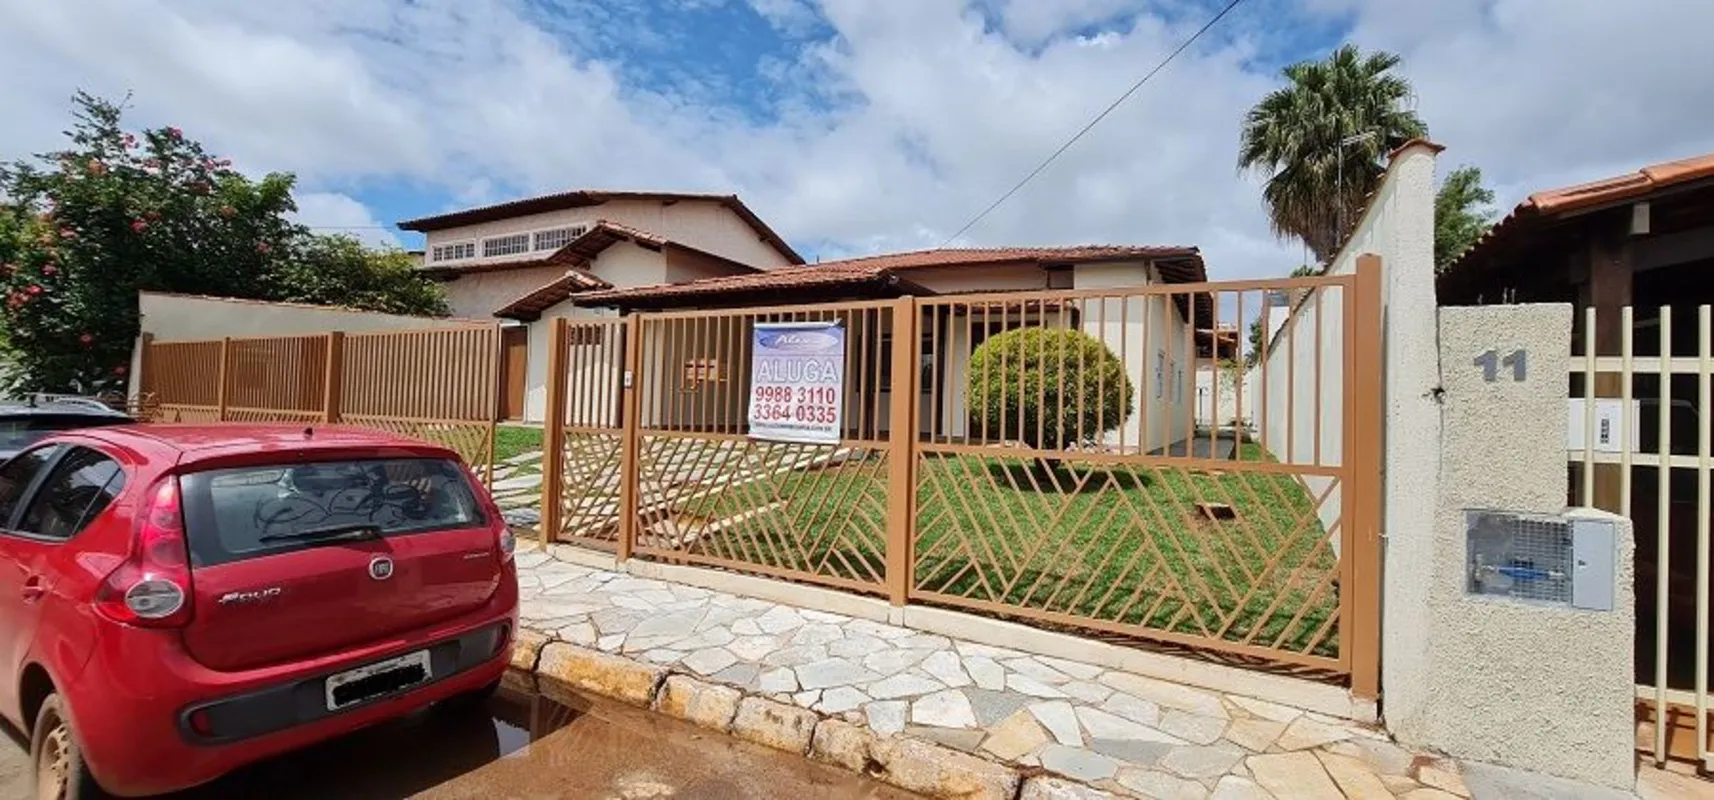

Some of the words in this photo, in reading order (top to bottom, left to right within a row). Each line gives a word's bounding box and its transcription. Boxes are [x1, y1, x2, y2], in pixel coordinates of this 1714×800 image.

[757, 358, 837, 383] ALUGA
[1473, 349, 1526, 382] 11
[755, 386, 793, 403] 9988
[797, 387, 836, 405] 3110
[753, 404, 791, 421] 3364
[796, 405, 837, 423] 0335
